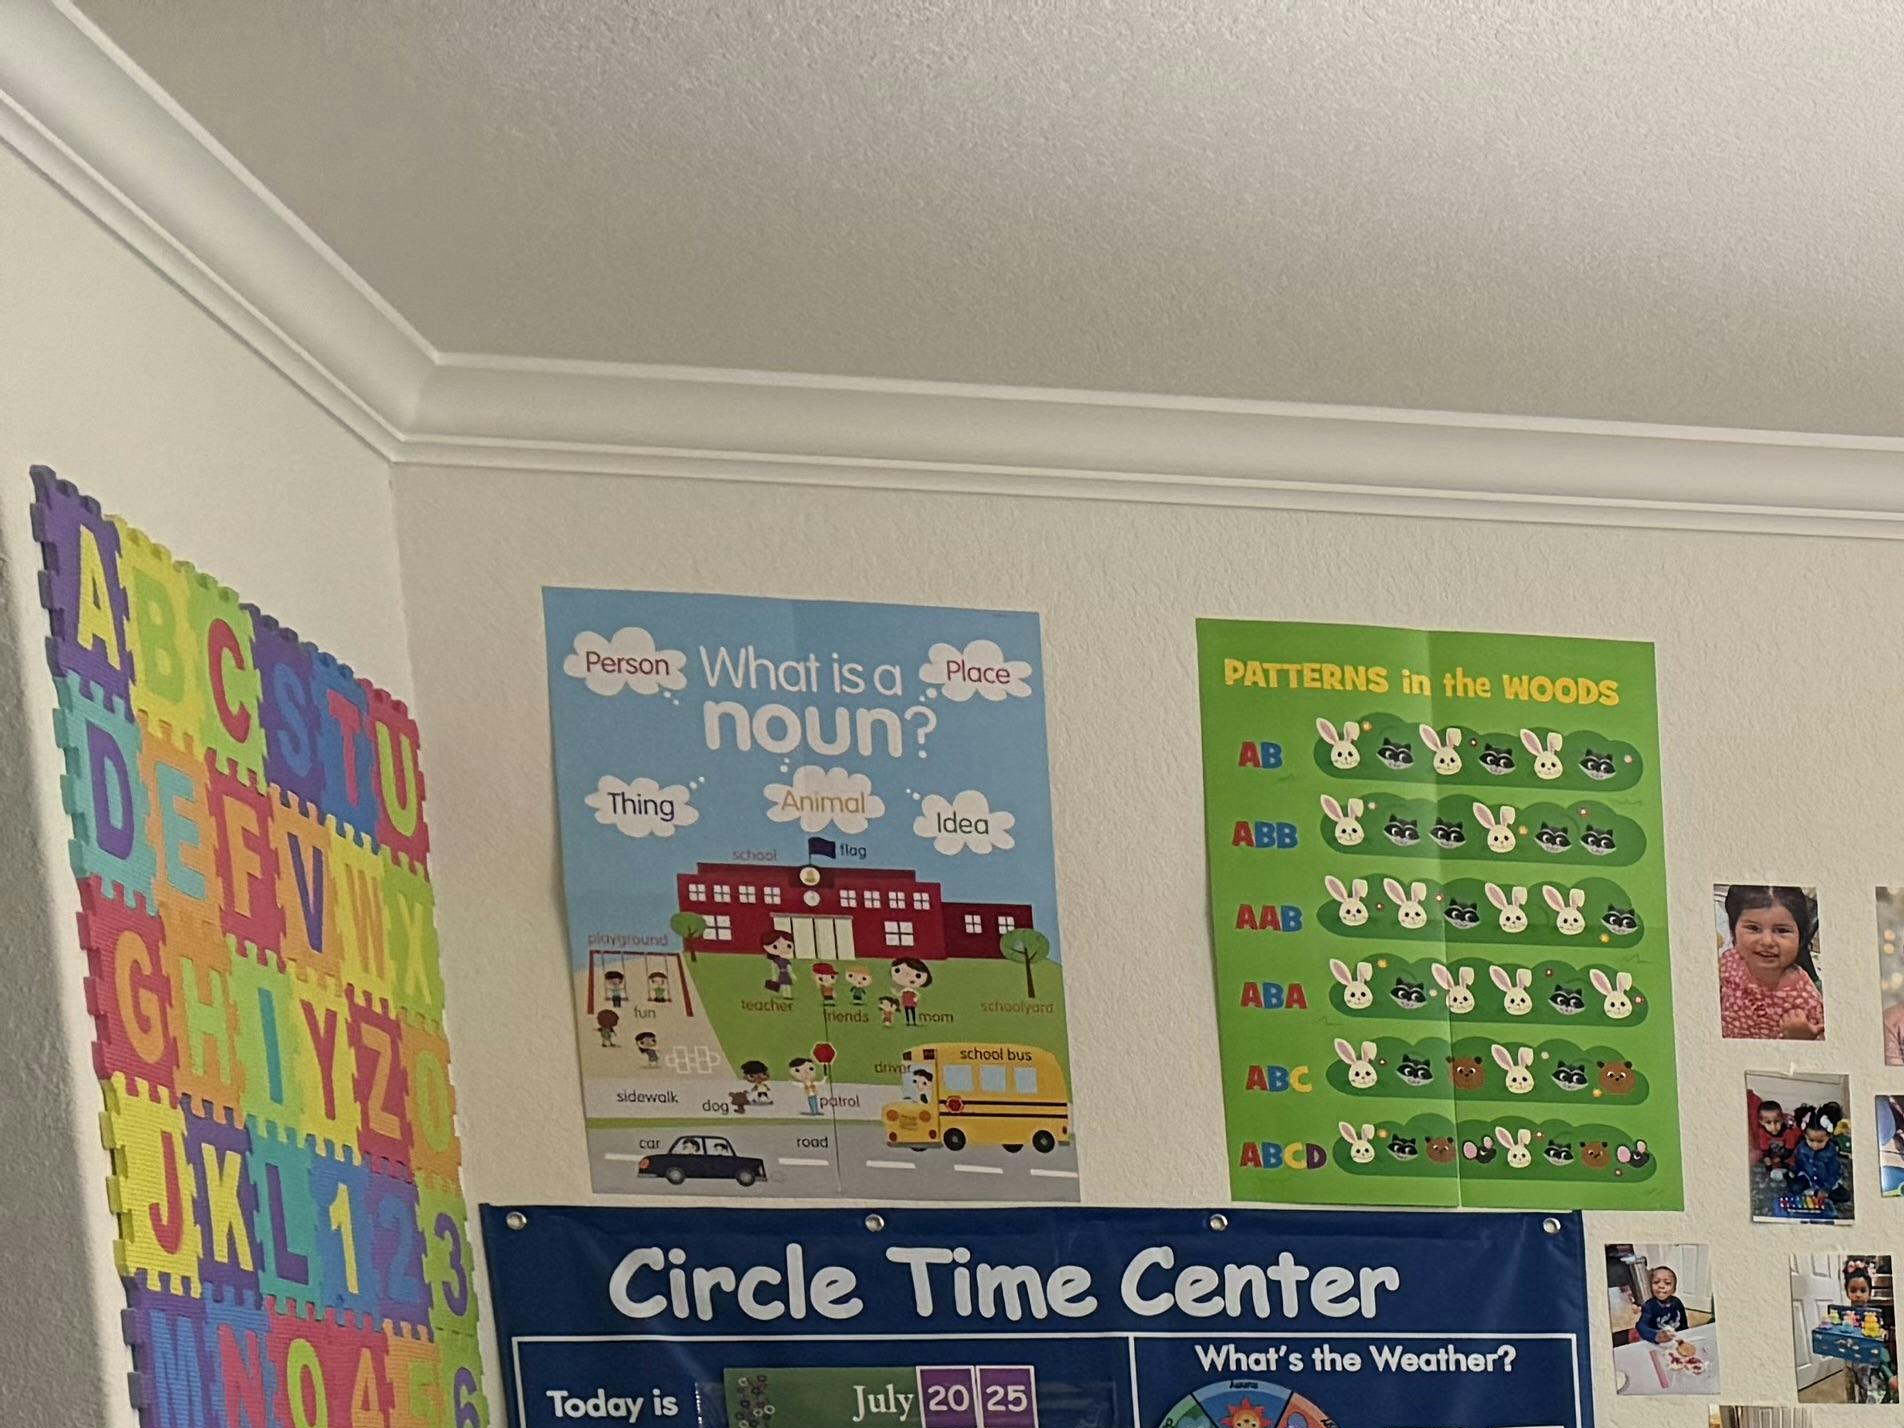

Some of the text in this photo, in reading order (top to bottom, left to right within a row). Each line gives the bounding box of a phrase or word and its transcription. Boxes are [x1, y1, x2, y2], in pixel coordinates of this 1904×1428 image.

[587, 650, 670, 677] Person
[700, 645, 902, 697] What is a
[947, 659, 1011, 687] Place
[1224, 658, 1620, 705] PATTERNS in the WOODS
[704, 701, 937, 759] noun?
[1238, 740, 1283, 769] AB
[607, 792, 674, 822] Thing
[782, 789, 865, 815] Animal
[936, 813, 989, 836] Idea
[1232, 820, 1298, 849] ABB
[840, 843, 867, 861] flag
[1235, 903, 1303, 933] AAB
[741, 1000, 793, 1012] teacher
[1241, 981, 1308, 1009] ABA
[633, 1006, 656, 1020] fun
[918, 1011, 954, 1023] mom
[960, 1048, 1032, 1061] school bus
[1245, 1064, 1312, 1093] ABC
[617, 1090, 678, 1105] sidewalk
[702, 1100, 729, 1114] dog
[639, 1136, 660, 1150] car
[797, 1134, 828, 1149] road
[1240, 1140, 1327, 1169] ABCD
[610, 1243, 1400, 1322] Circle Time Center
[1195, 1344, 1517, 1372] What's the Weather?
[547, 1384, 1028, 1422] Today is July 20 25
